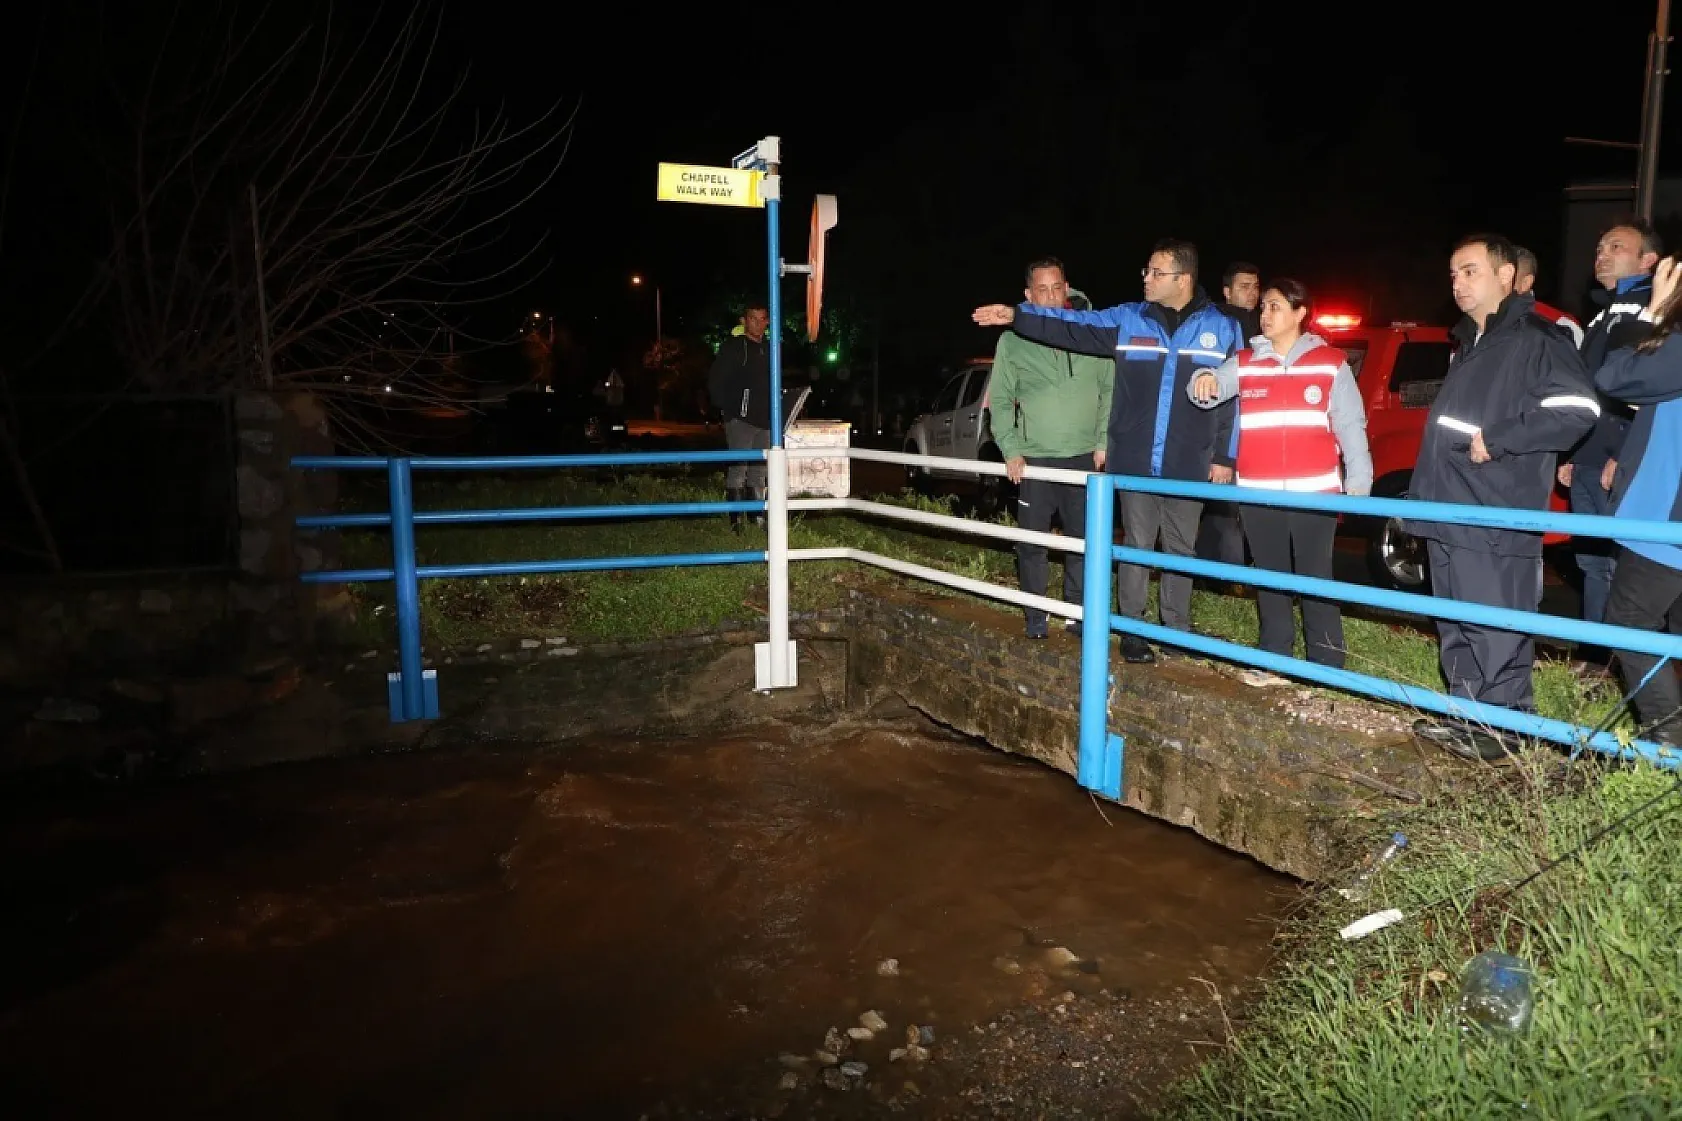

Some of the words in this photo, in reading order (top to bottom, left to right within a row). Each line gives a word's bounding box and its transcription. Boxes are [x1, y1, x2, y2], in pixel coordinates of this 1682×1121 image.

[681, 173, 729, 185] CHAPELL
[676, 185, 706, 196] WALK
[710, 187, 733, 197] WAY
